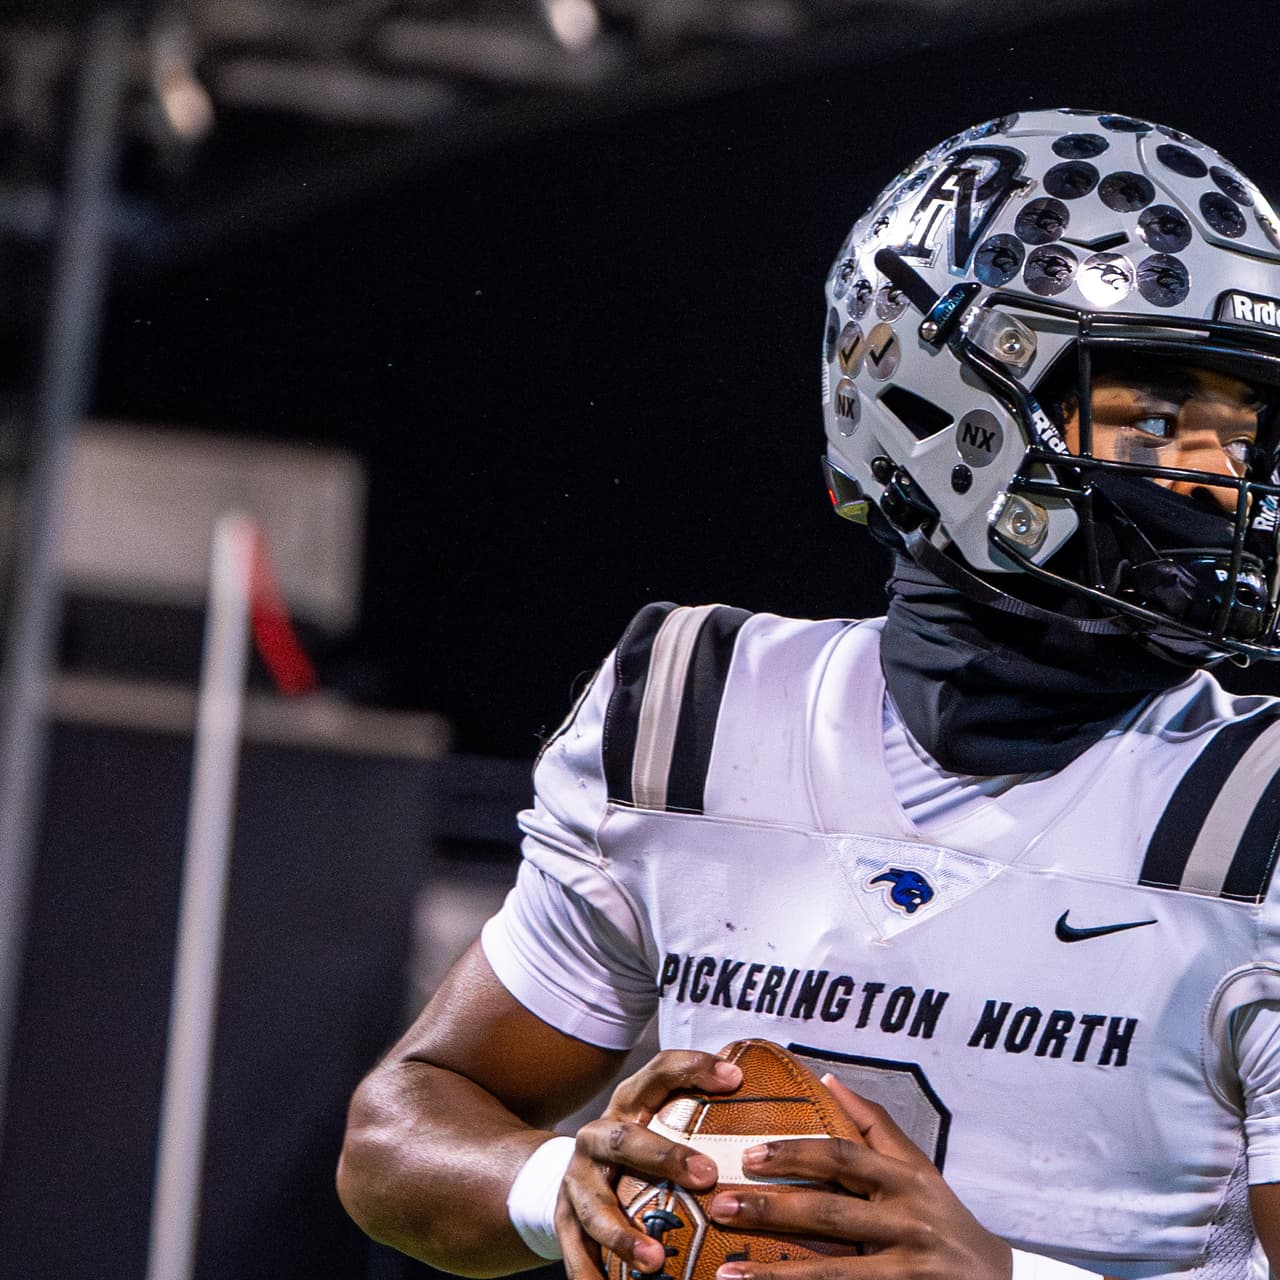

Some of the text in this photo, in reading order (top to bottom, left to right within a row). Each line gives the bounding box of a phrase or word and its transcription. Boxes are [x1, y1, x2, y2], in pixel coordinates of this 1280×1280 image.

[962, 422, 995, 452] NX
[658, 952, 1138, 1067] PICKERINGTON NORTH
